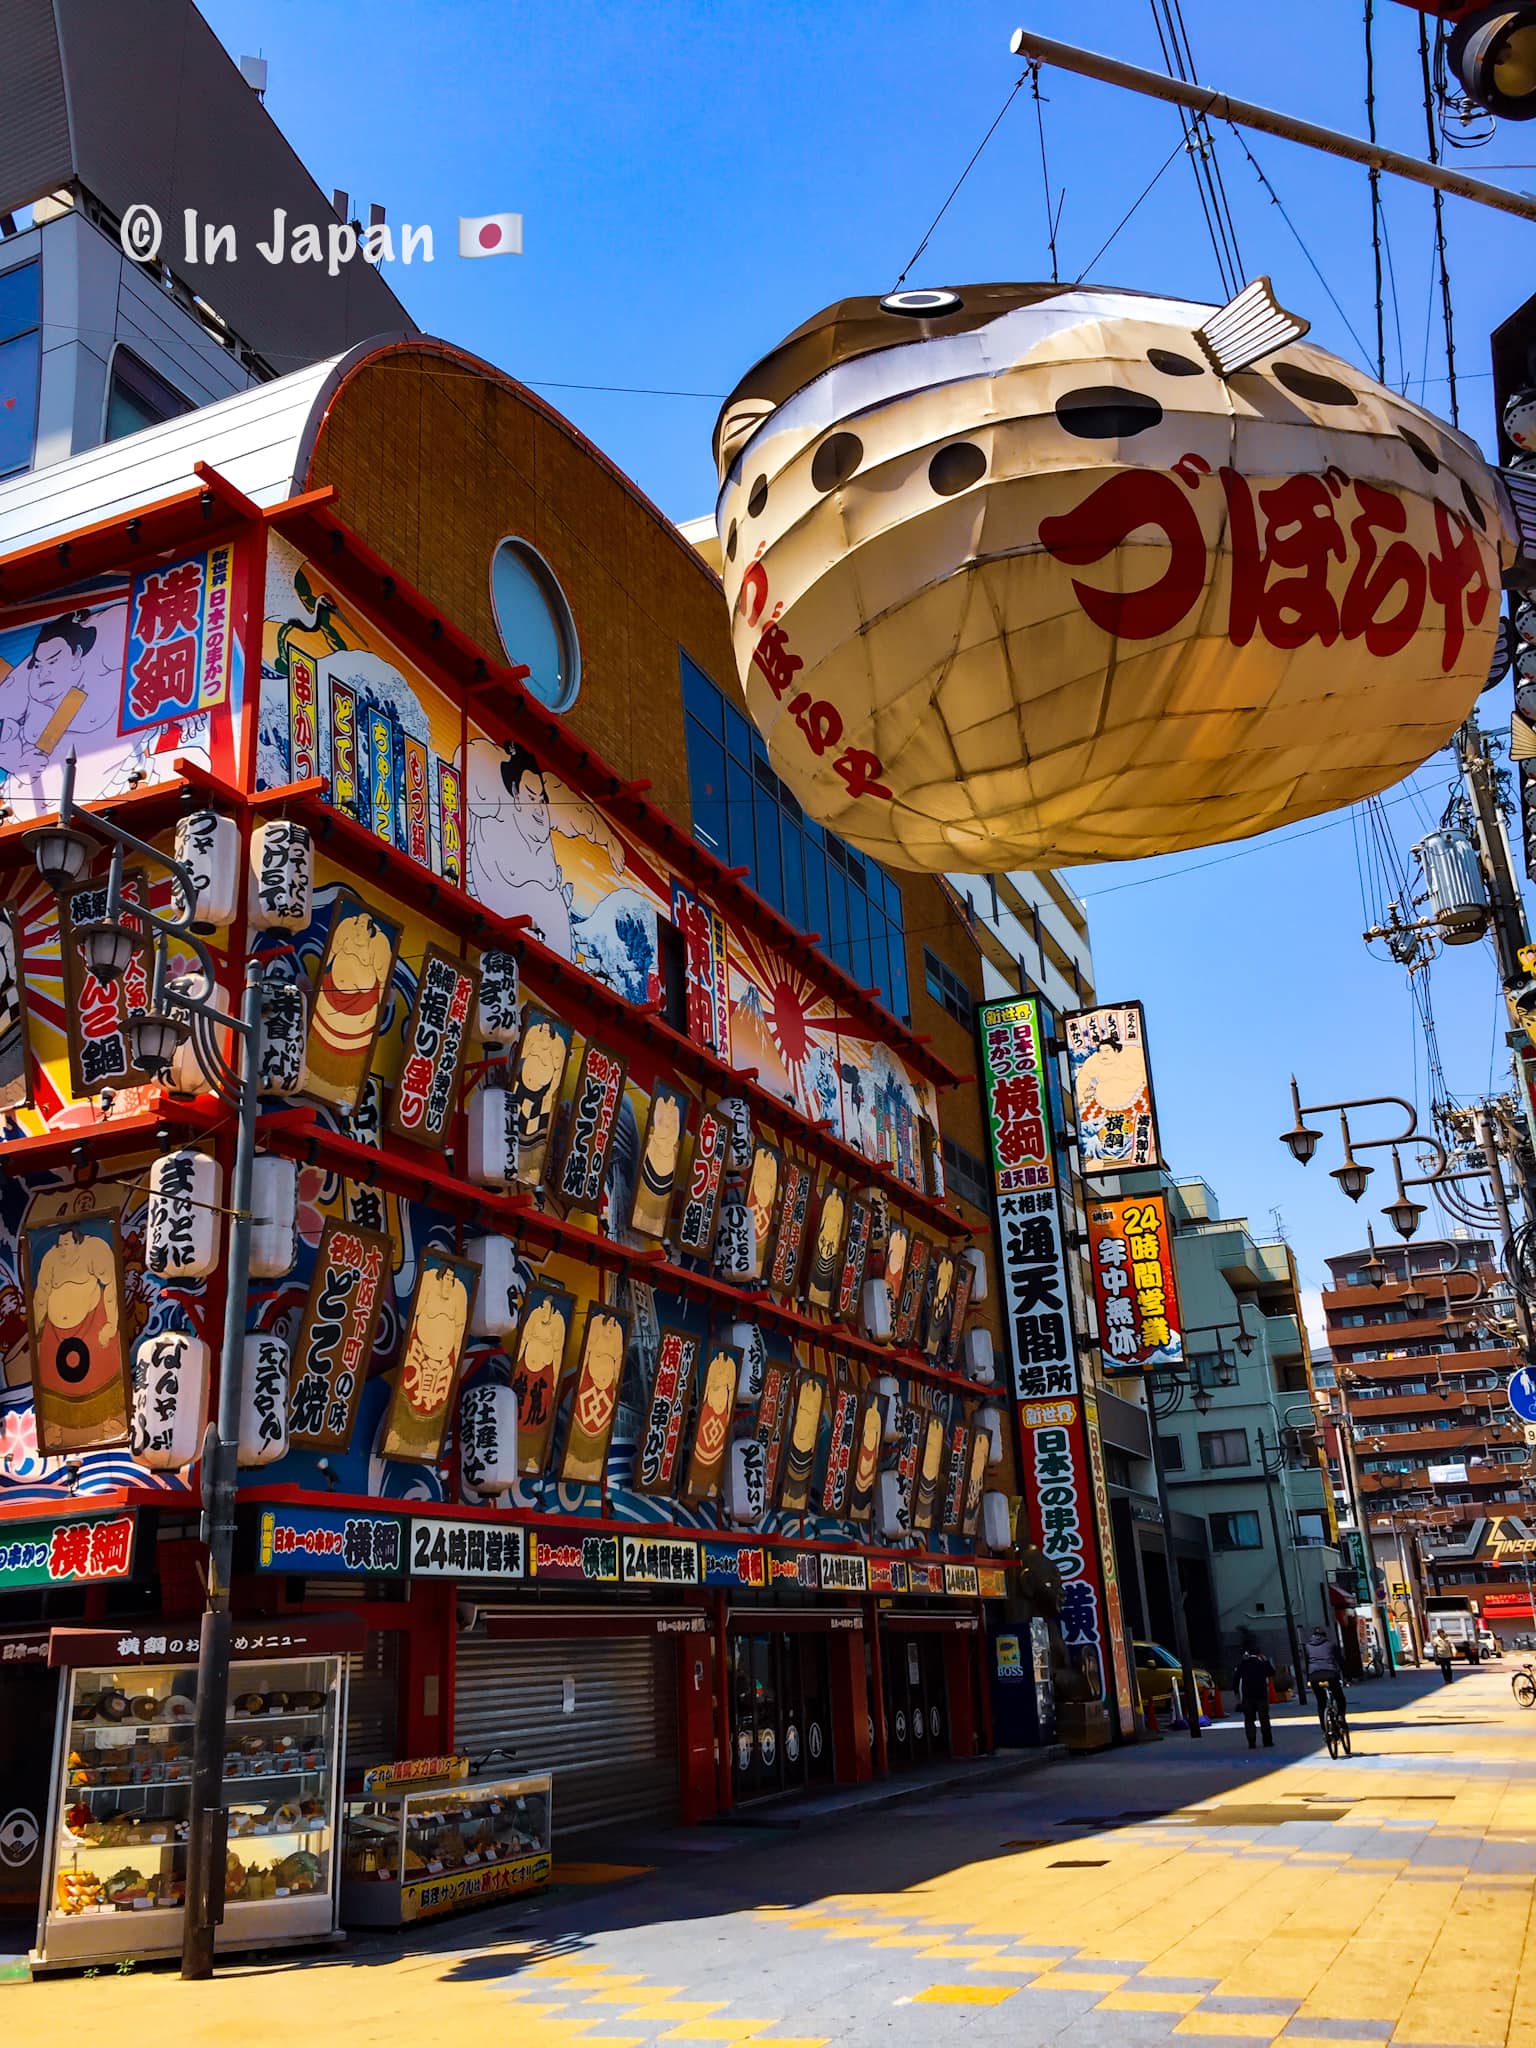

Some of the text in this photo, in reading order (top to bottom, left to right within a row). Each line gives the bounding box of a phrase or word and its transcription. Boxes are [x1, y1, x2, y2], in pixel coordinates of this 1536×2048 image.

[211, 549, 229, 587] 新世界
[130, 562, 203, 718] 横綱
[204, 587, 227, 697] 日本一の串かつ
[292, 659, 314, 779] 串かつ
[984, 1003, 1032, 1027] 新世界
[987, 1028, 1012, 1076] 串かつ
[1013, 1023, 1036, 1072] 日本一の
[992, 1074, 1046, 1168] 横綱
[680, 1113, 718, 1247] もつ鍋
[1000, 1165, 1050, 1189] 通天閣店
[1001, 1191, 1054, 1217] 大相撲
[328, 1231, 364, 1267] 名物
[1006, 1215, 1067, 1366] 通天閣
[1098, 1237, 1138, 1355] 年中無休
[1123, 1204, 1171, 1347] 24時間営業
[289, 1267, 361, 1435] どて焼
[328, 1243, 383, 1435] 大阪下町の味
[1018, 1363, 1073, 1396] 場所
[1024, 1403, 1076, 1427] 新世界
[1034, 1427, 1085, 1580] 日本一の串かつ
[48, 1518, 132, 1578] 横綱
[273, 1519, 400, 1570] 日本一の串かつ 横綱
[414, 1526, 520, 1572] 24時間営業
[582, 1537, 618, 1578] 横綱
[626, 1543, 696, 1581] 24時間営業
[997, 1665, 1024, 1677] BOSS
